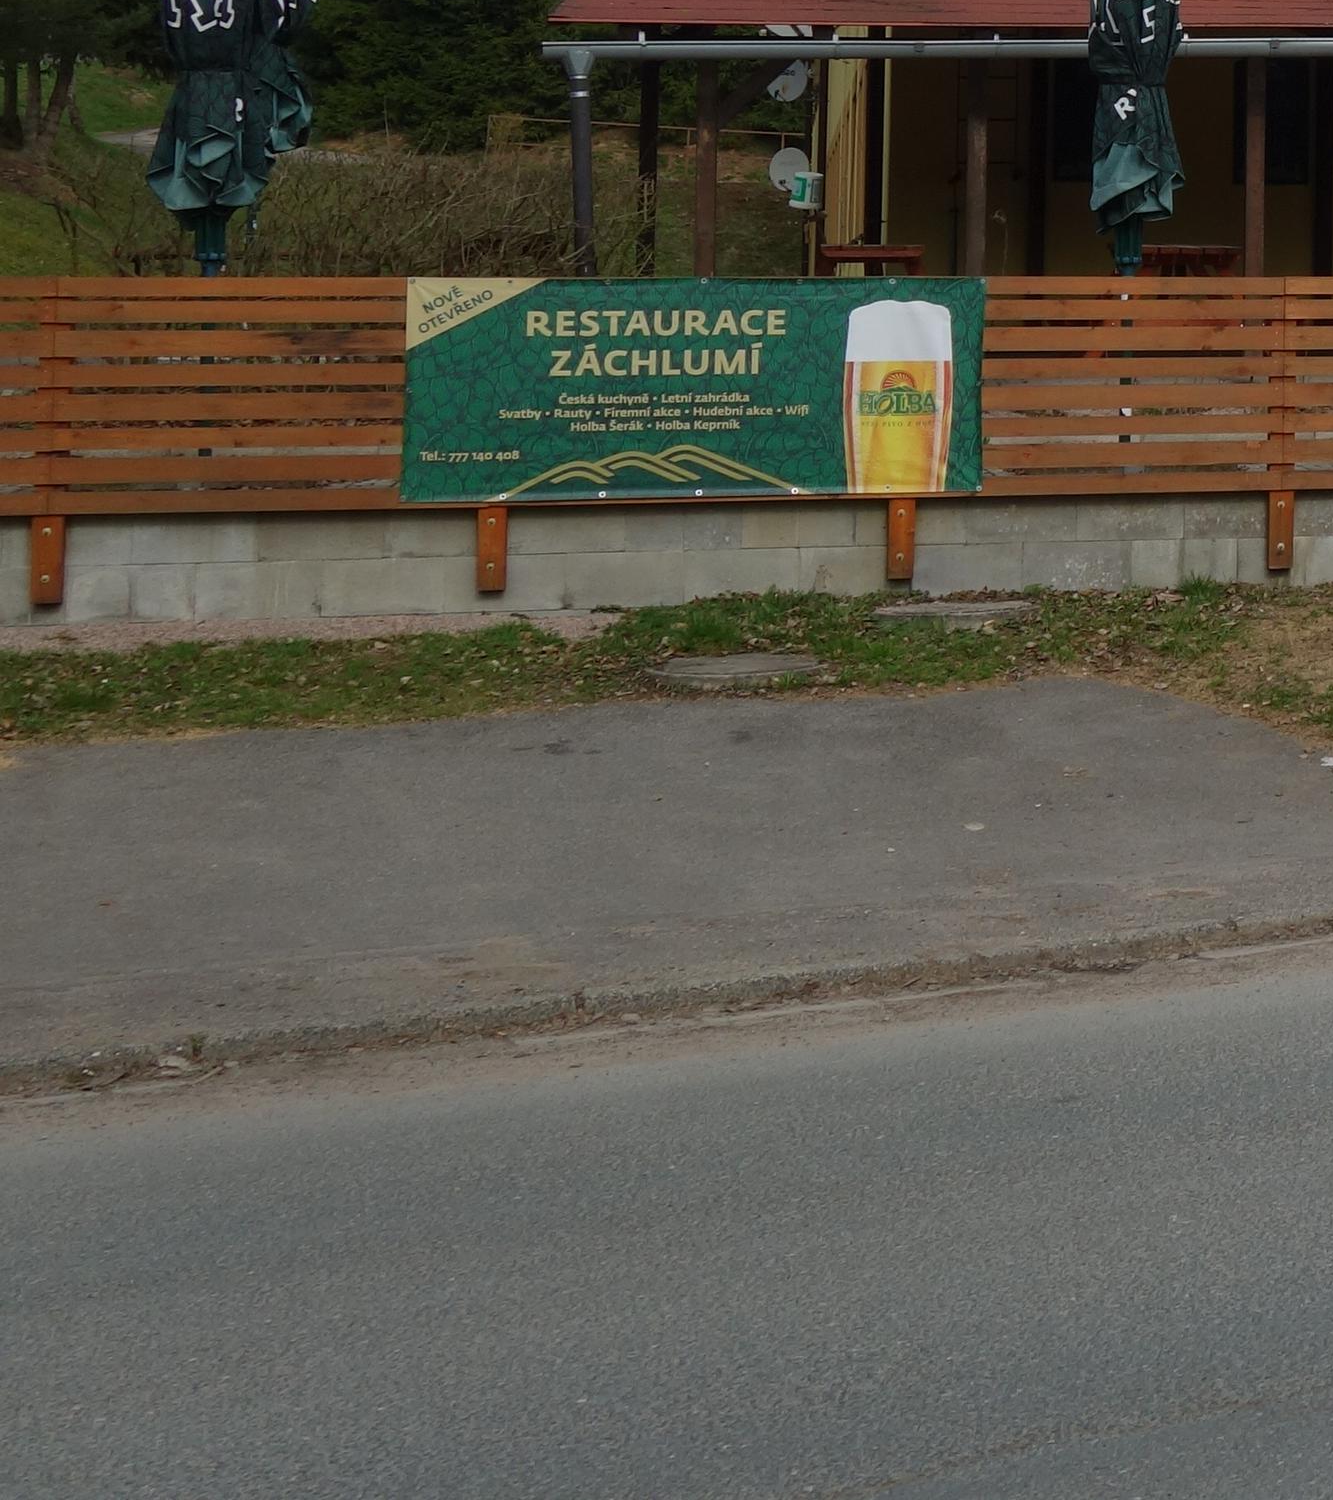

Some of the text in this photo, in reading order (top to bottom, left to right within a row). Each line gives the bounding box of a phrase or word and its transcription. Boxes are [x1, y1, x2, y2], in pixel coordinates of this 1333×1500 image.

[417, 289, 494, 334] OTEVŘENO
[422, 285, 464, 314] NOVĚ
[526, 309, 786, 337] RESTAURACE
[549, 342, 763, 377] ZÁCHLUMÍ
[558, 392, 750, 405] Česká kuchyně Letní zahrádka
[857, 391, 938, 416] HOLBA
[499, 404, 809, 420] Svatby Rauty Firemní akce Hudební akce Wifi
[570, 419, 740, 432] Holba Šerák Holba Keprník
[420, 450, 520, 462] Tel.: 777 140 408
